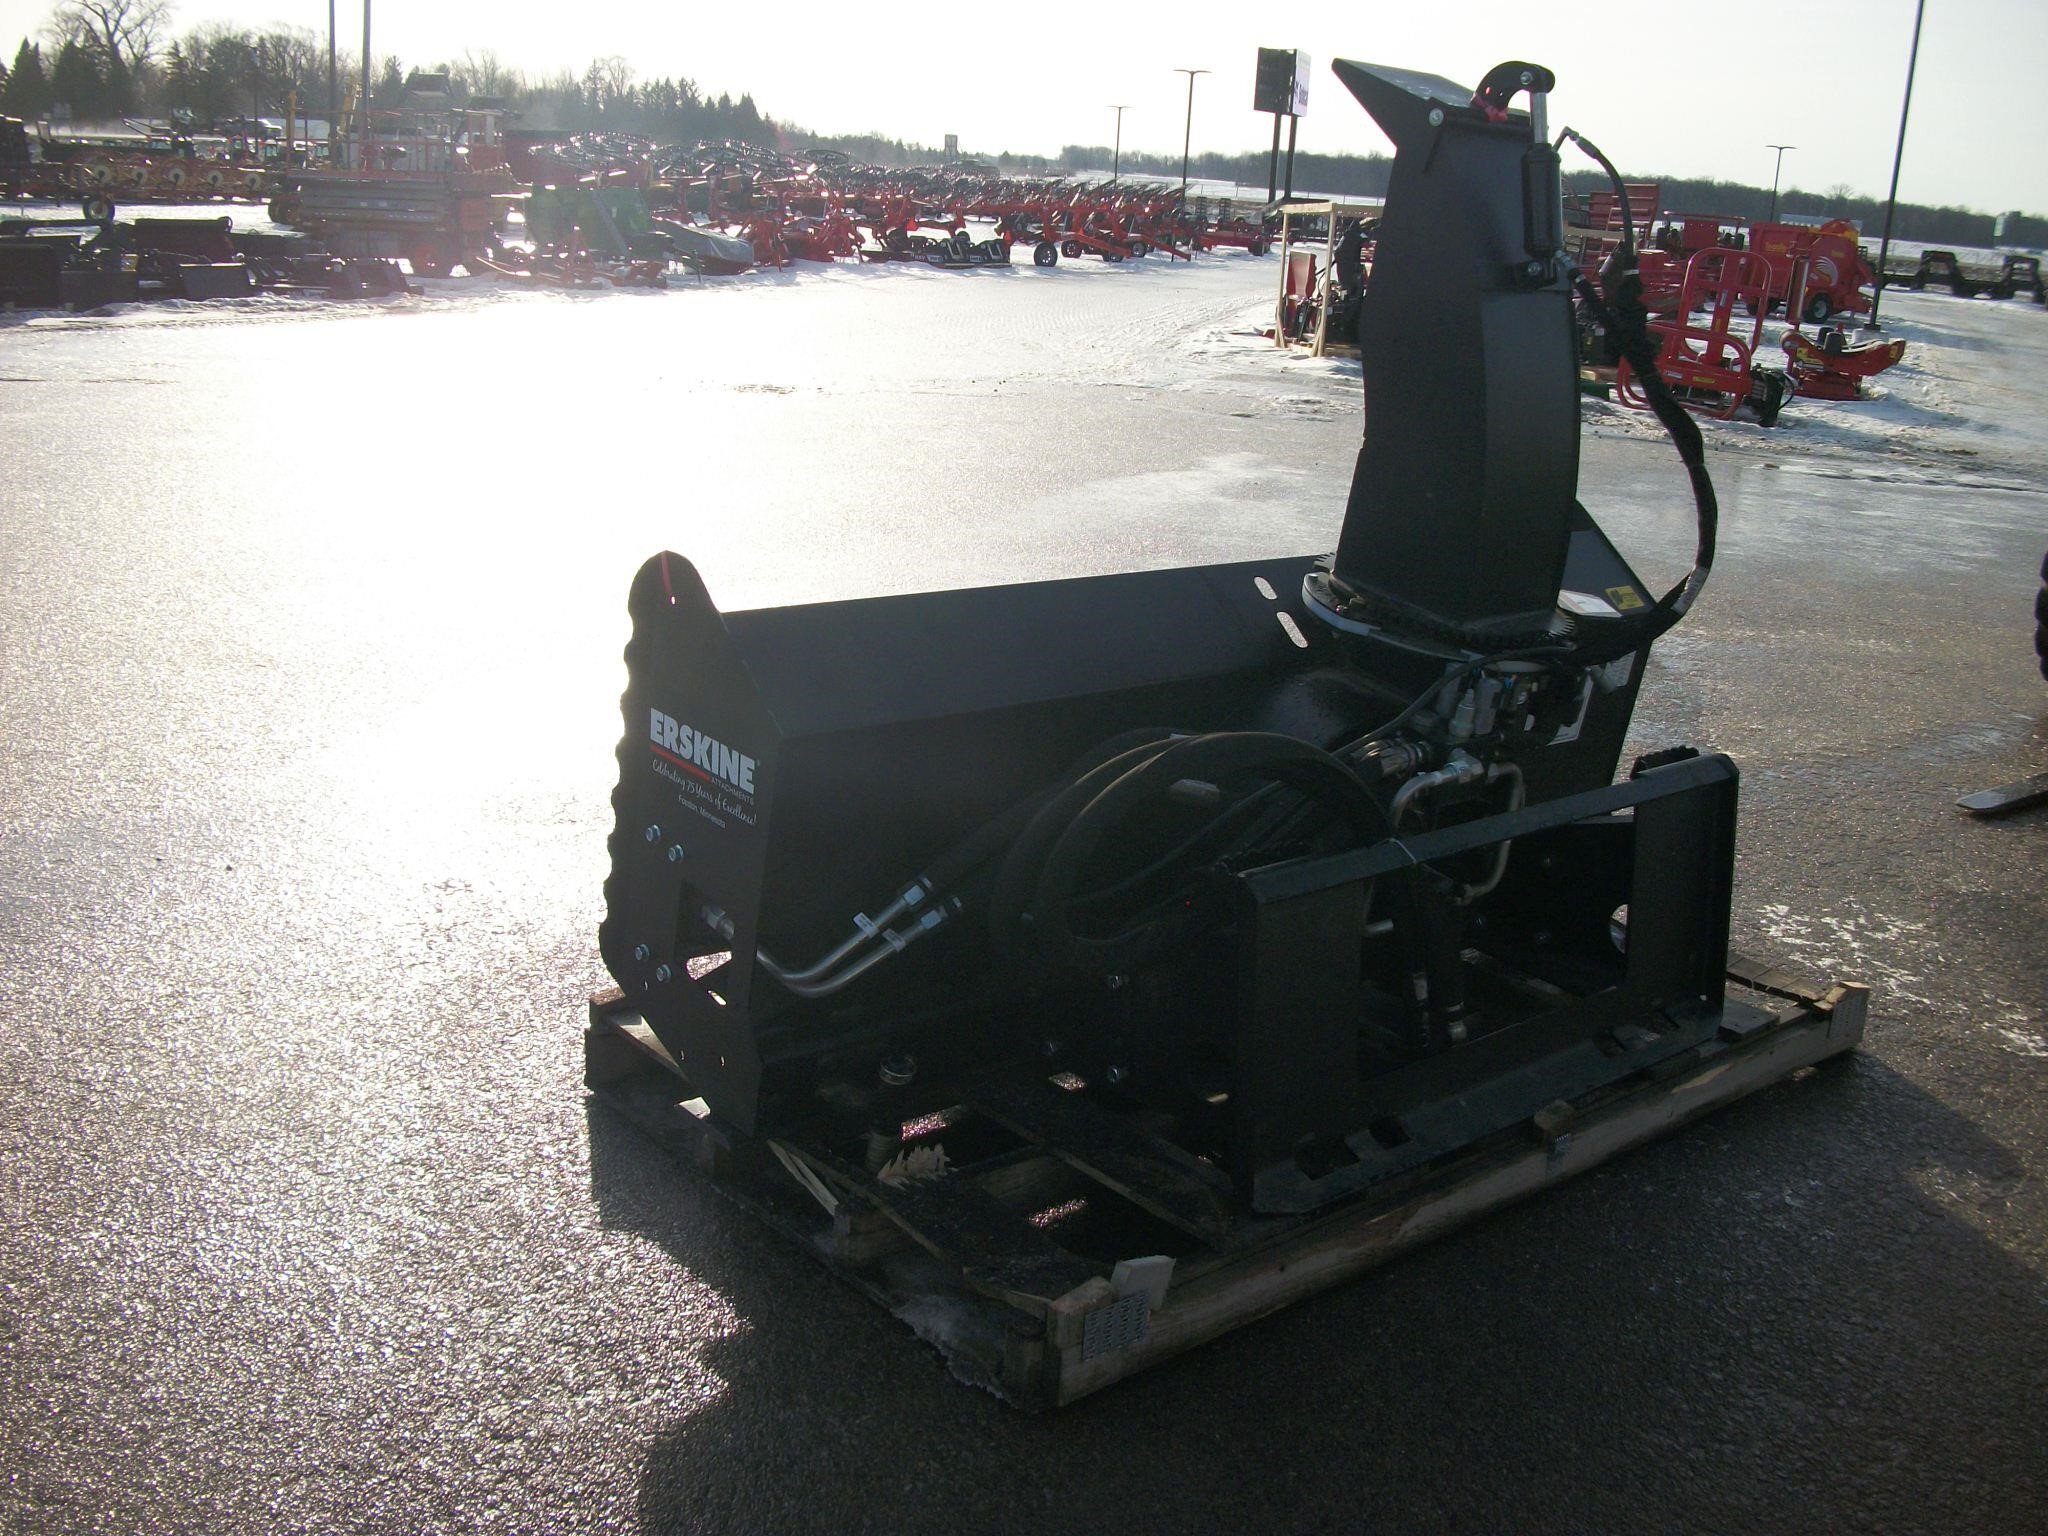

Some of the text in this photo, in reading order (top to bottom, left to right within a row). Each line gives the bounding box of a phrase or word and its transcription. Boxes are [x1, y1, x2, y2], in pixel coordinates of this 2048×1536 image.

[650, 708, 755, 795] ERSKINE
[652, 758, 757, 826] Celebrating 75 Years of Excellence!
[712, 777, 754, 806] ATTACHMENTS
